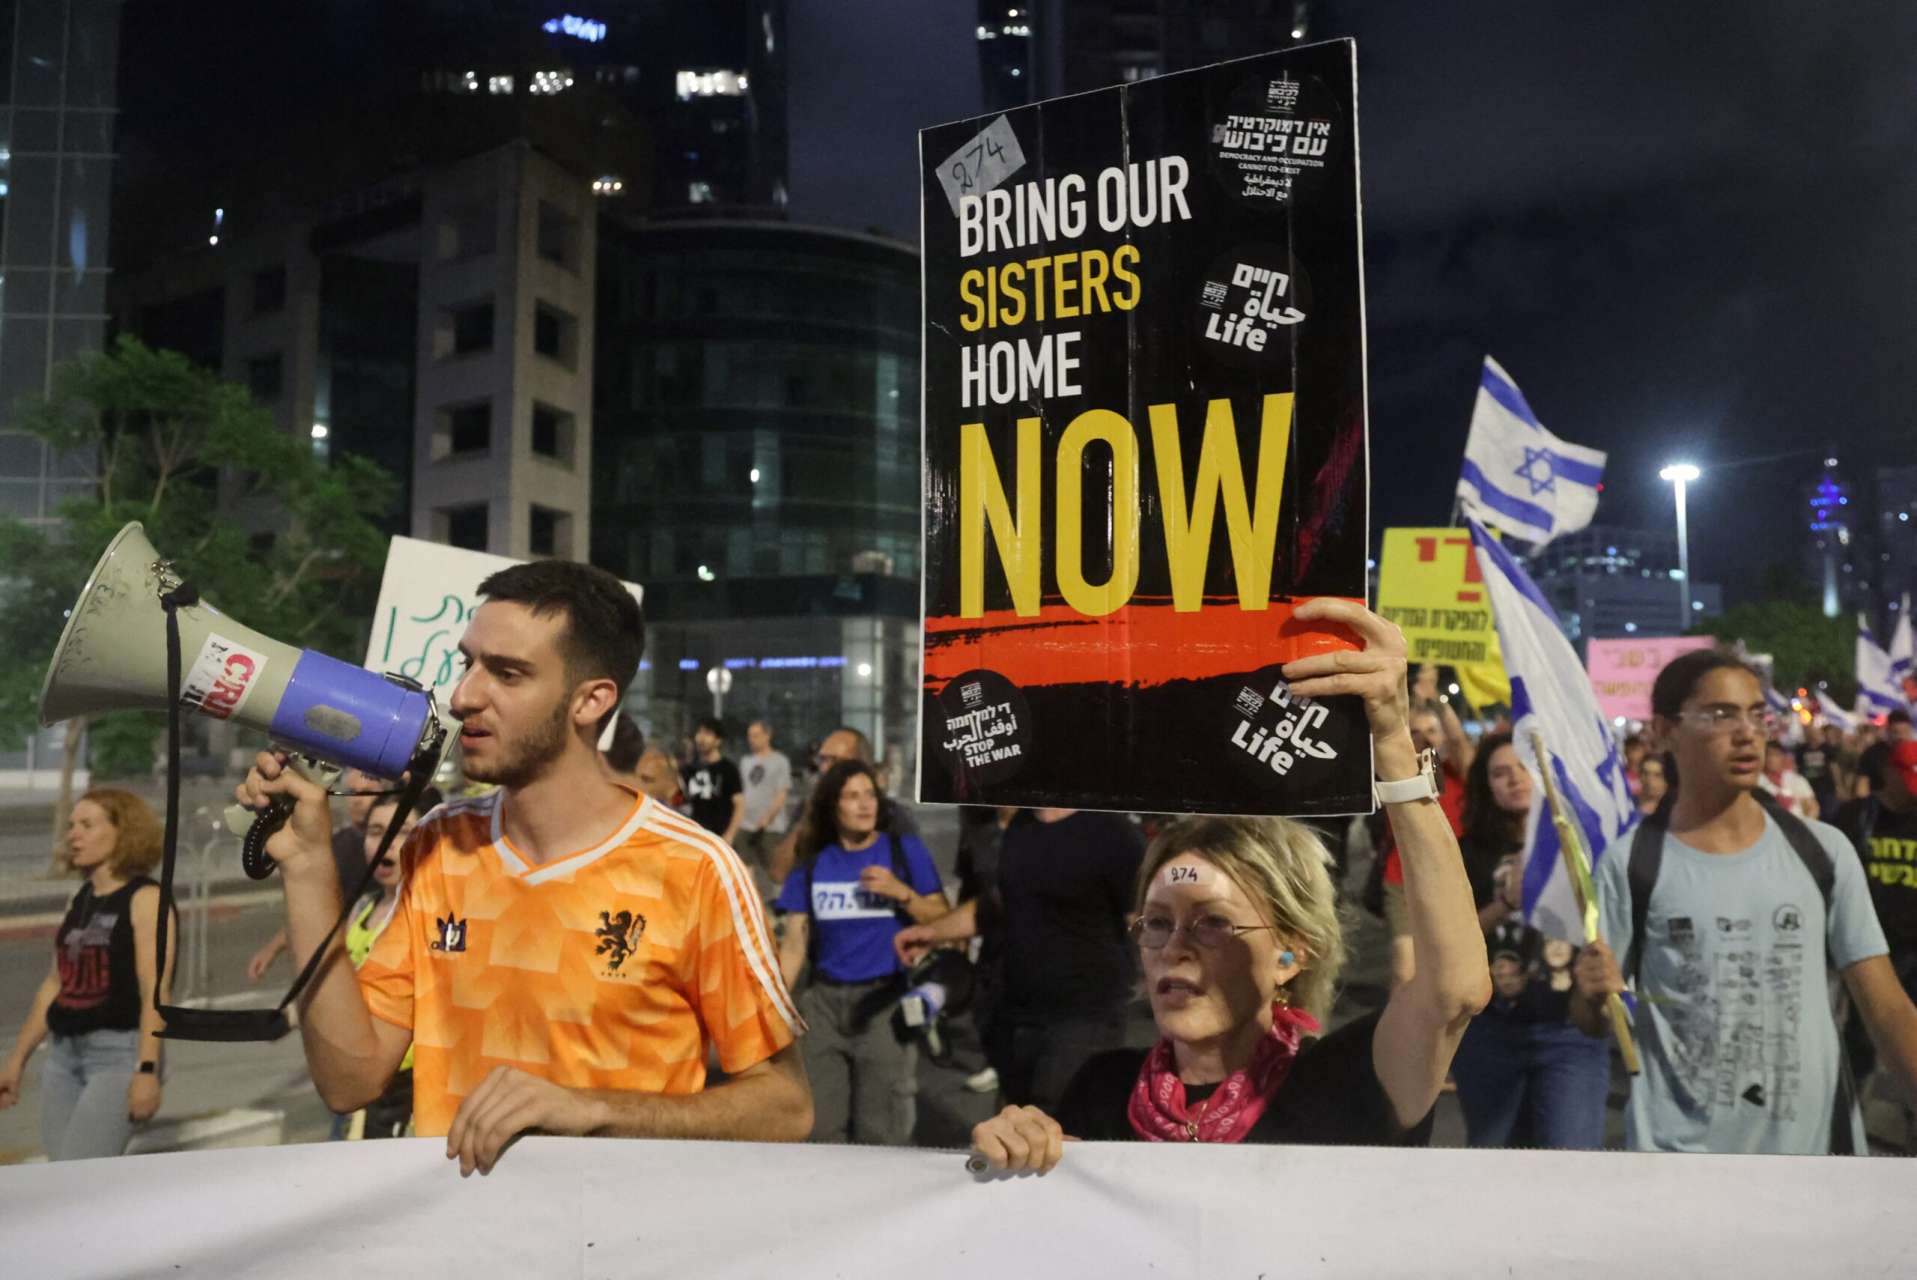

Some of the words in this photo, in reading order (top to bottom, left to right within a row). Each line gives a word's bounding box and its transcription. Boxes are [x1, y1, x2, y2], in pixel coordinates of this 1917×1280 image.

[1226, 115, 1305, 134] דמוקרטיה
[1306, 121, 1331, 137] אין
[1222, 130, 1289, 153] כיבוש
[1292, 135, 1328, 156] עם
[952, 136, 1007, 194] 274
[1219, 151, 1262, 162] DEMOCRACY
[959, 173, 1087, 258] BRING
[1097, 155, 1193, 232] OUR
[959, 244, 1142, 333] SISTERS
[1231, 262, 1290, 298] חיים
[1204, 312, 1268, 352] Life
[961, 330, 1083, 408] HOME
[959, 391, 1296, 619] NOW
[997, 701, 1012, 715] די
[963, 737, 995, 757] STOP
[966, 752, 992, 768] THE
[991, 743, 1022, 762] WAR
[1231, 719, 1295, 777] Life
[1171, 866, 1198, 882] 274
